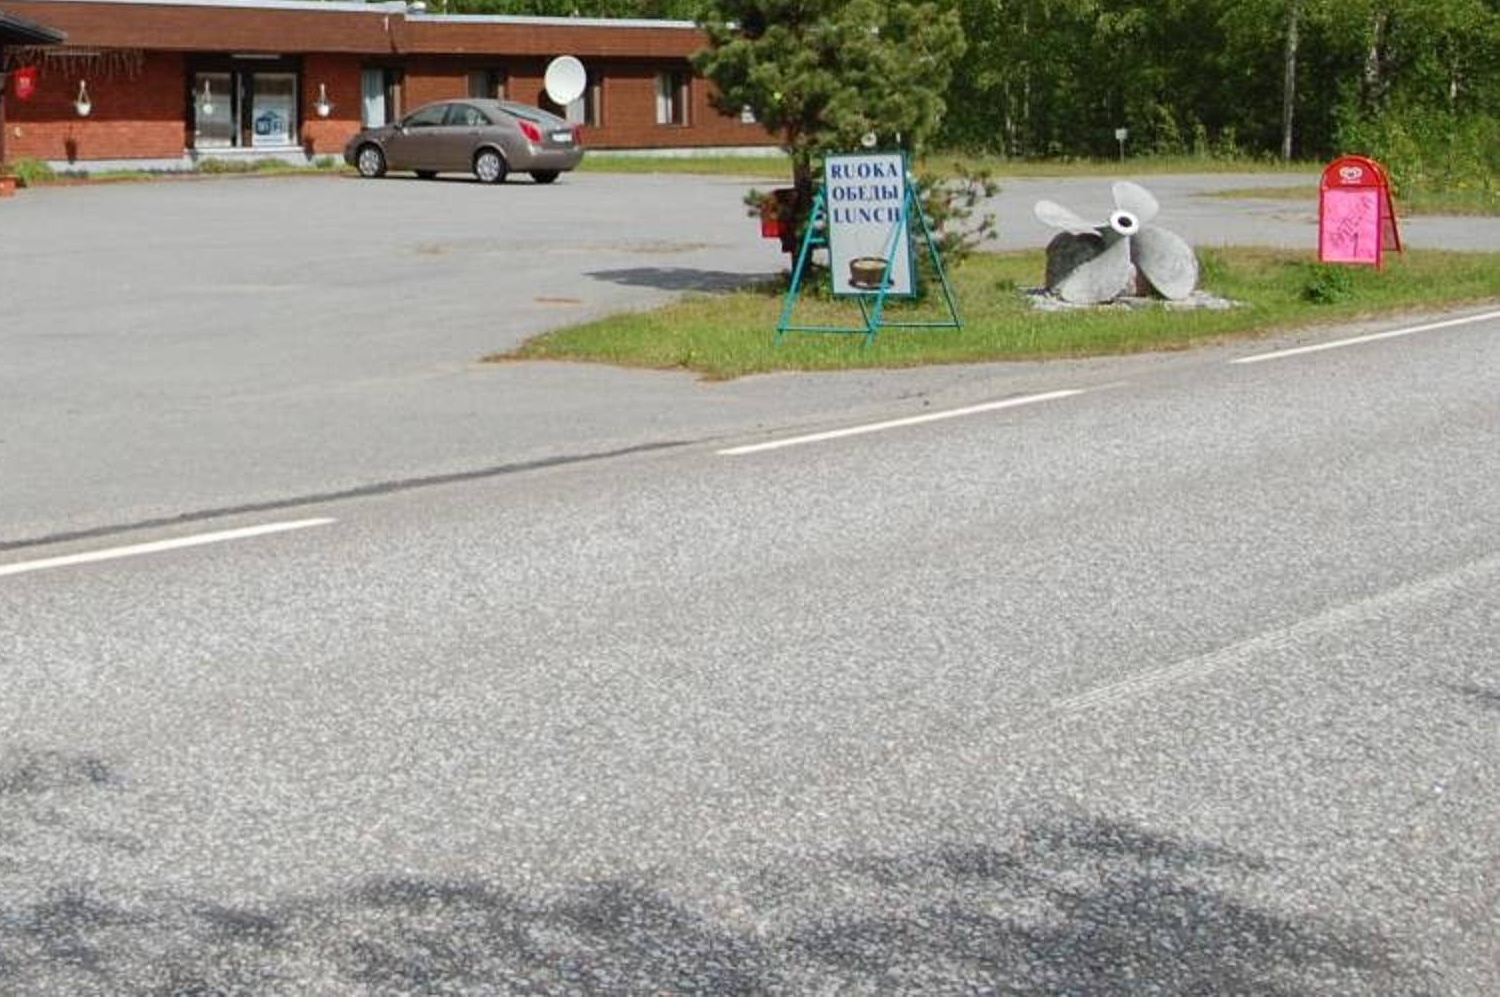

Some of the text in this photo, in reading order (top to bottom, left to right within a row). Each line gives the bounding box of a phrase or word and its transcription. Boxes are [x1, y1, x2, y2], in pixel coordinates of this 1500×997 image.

[831, 162, 898, 179] RUOKA
[832, 185, 899, 201] ОБЕДЫ
[833, 207, 900, 224] LUNCH
